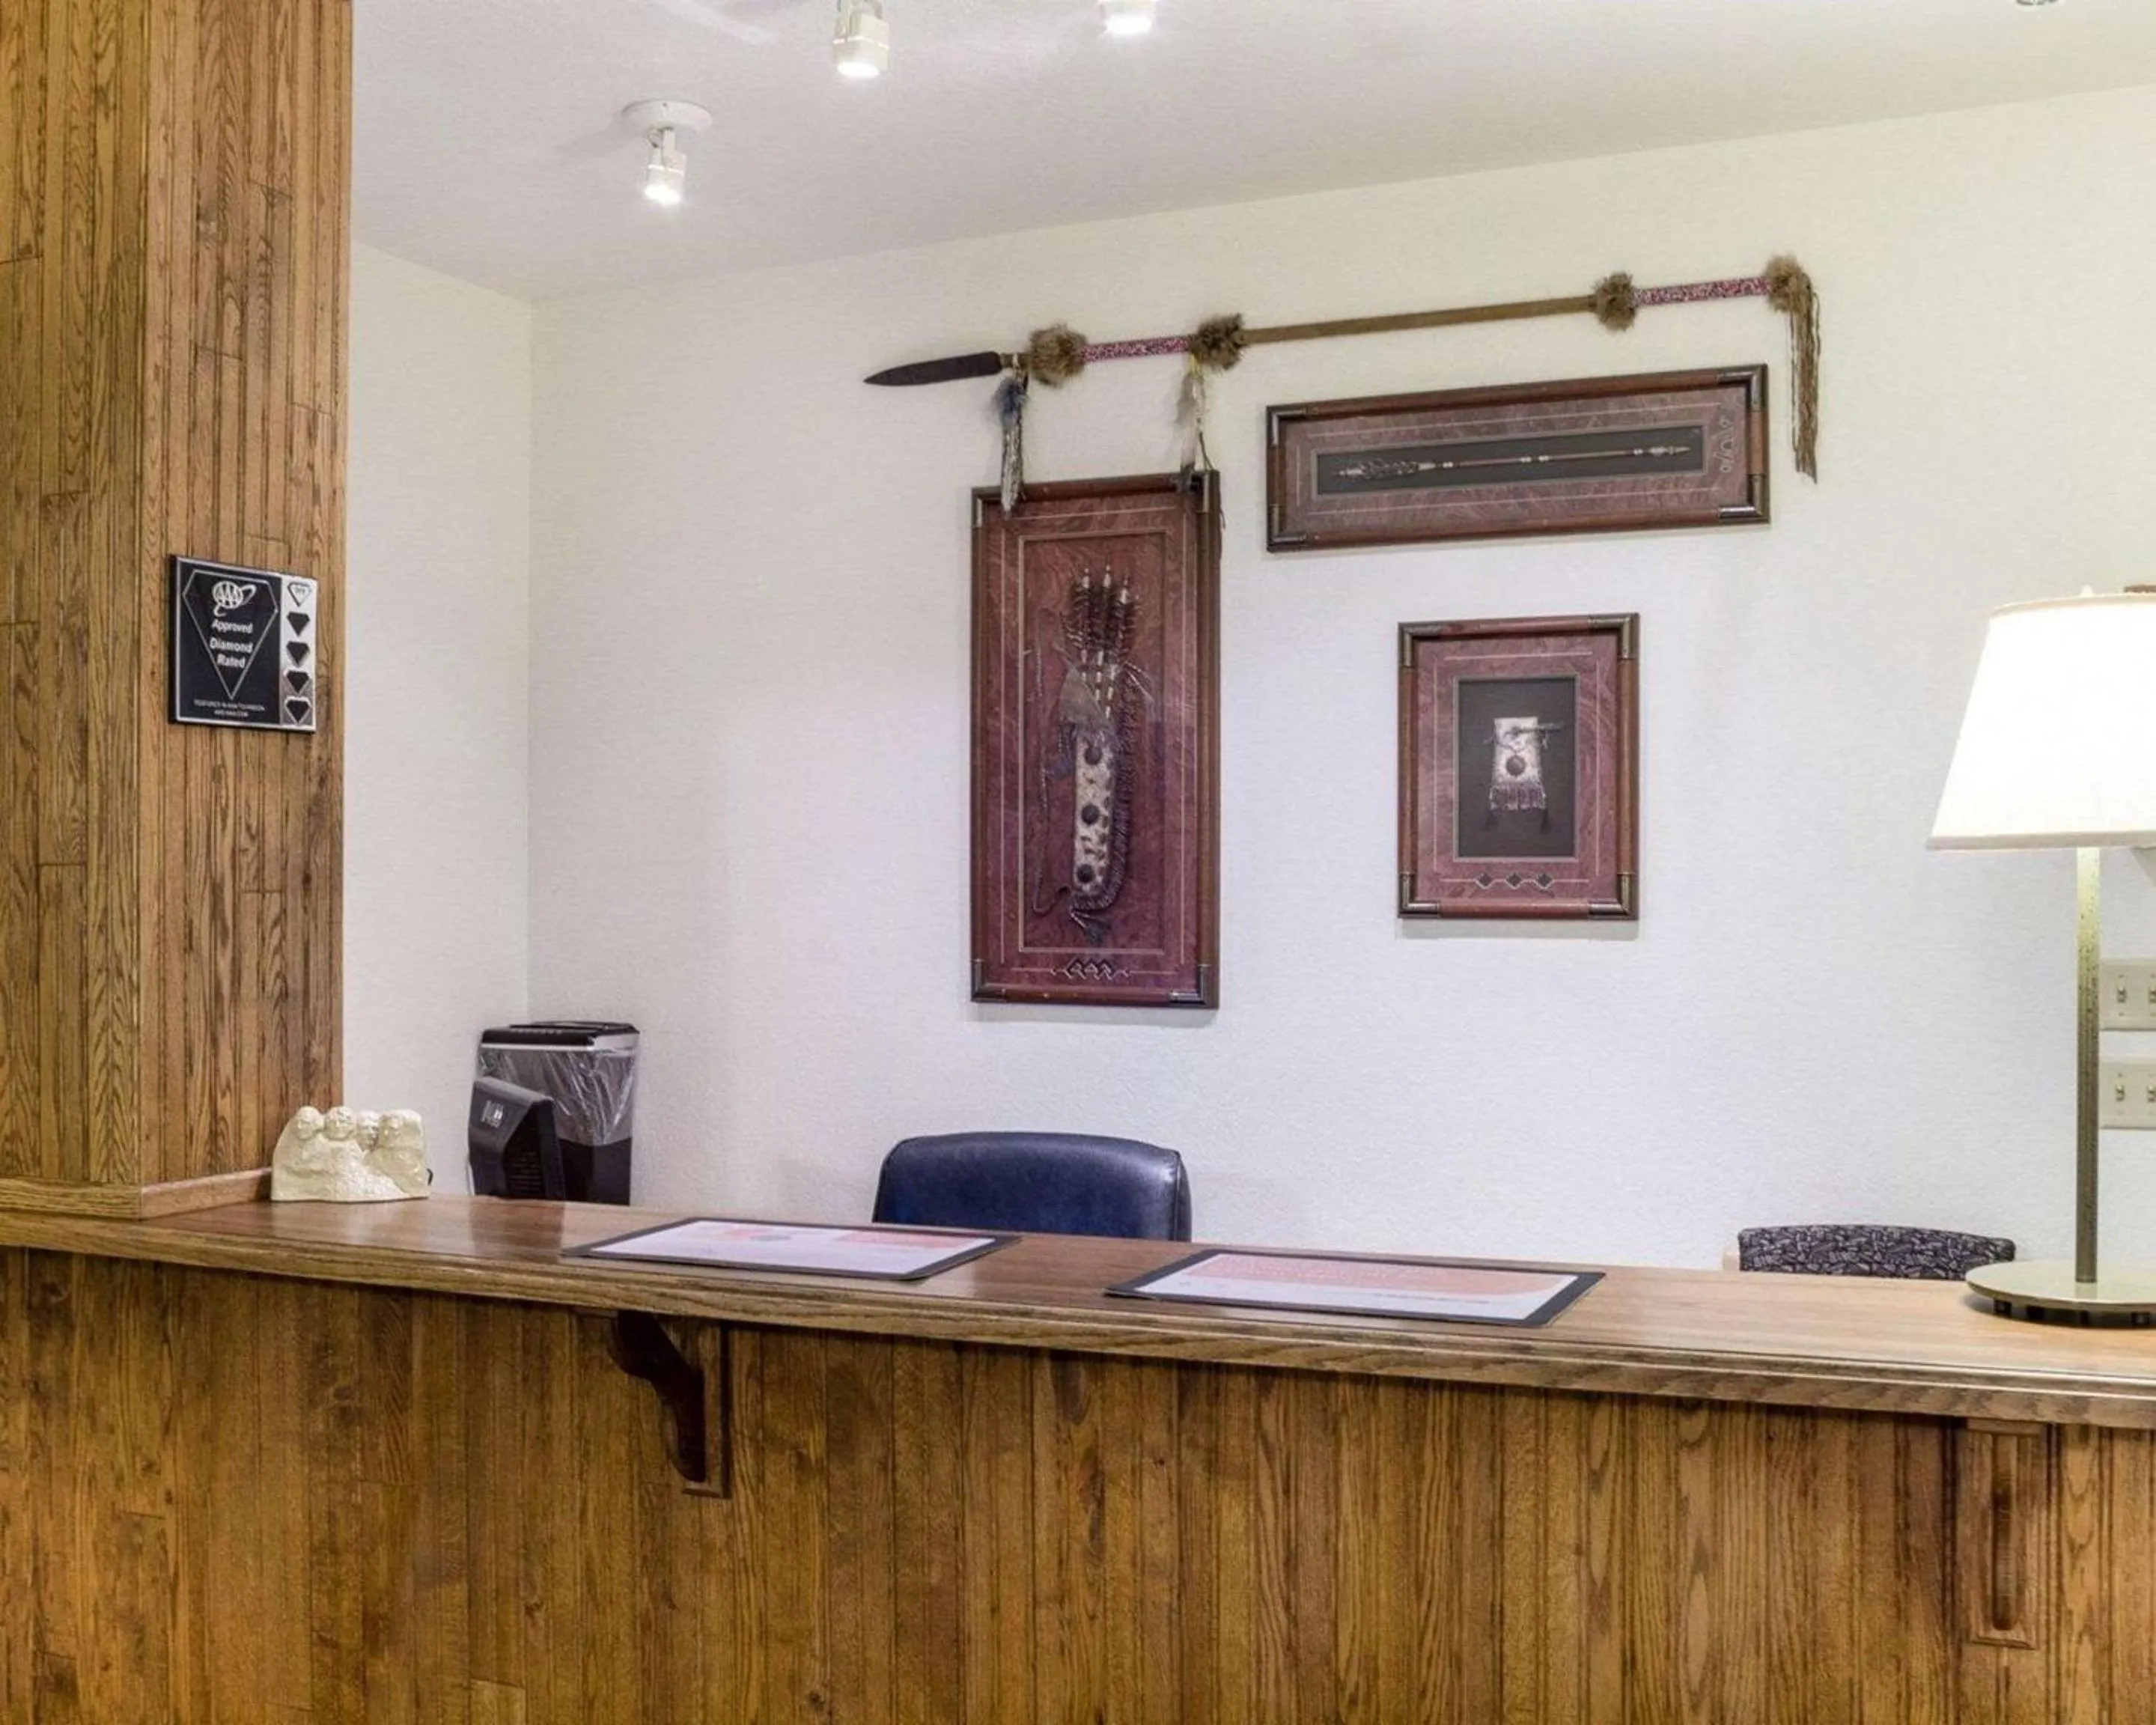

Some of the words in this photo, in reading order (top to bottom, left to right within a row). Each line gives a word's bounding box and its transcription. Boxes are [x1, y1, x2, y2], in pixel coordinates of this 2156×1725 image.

[211, 618, 253, 633] Approved
[210, 637, 253, 654] Diamond
[217, 654, 246, 668] Rated
